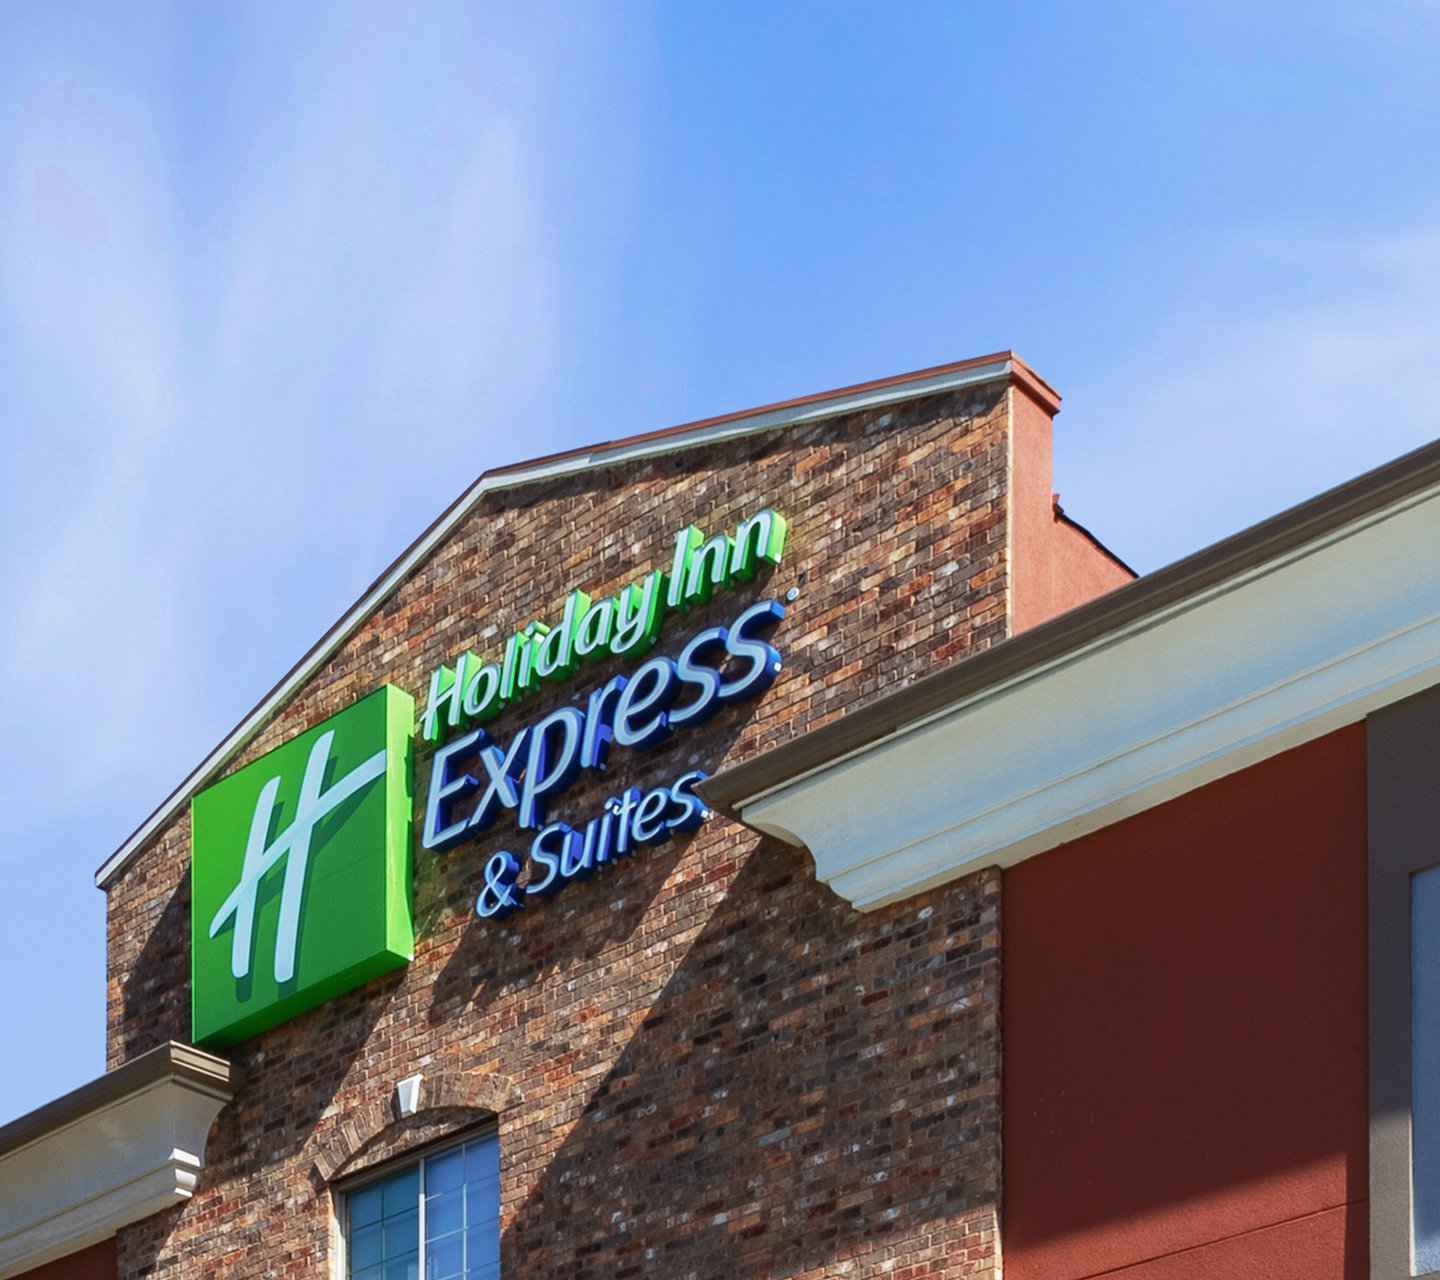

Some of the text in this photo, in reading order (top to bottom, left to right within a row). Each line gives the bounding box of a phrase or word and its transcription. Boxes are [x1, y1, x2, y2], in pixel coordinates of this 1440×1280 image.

[420, 508, 788, 745] Holiday Inn
[422, 599, 785, 853] Express
[208, 729, 387, 983] H
[475, 770, 710, 921] & Suites
